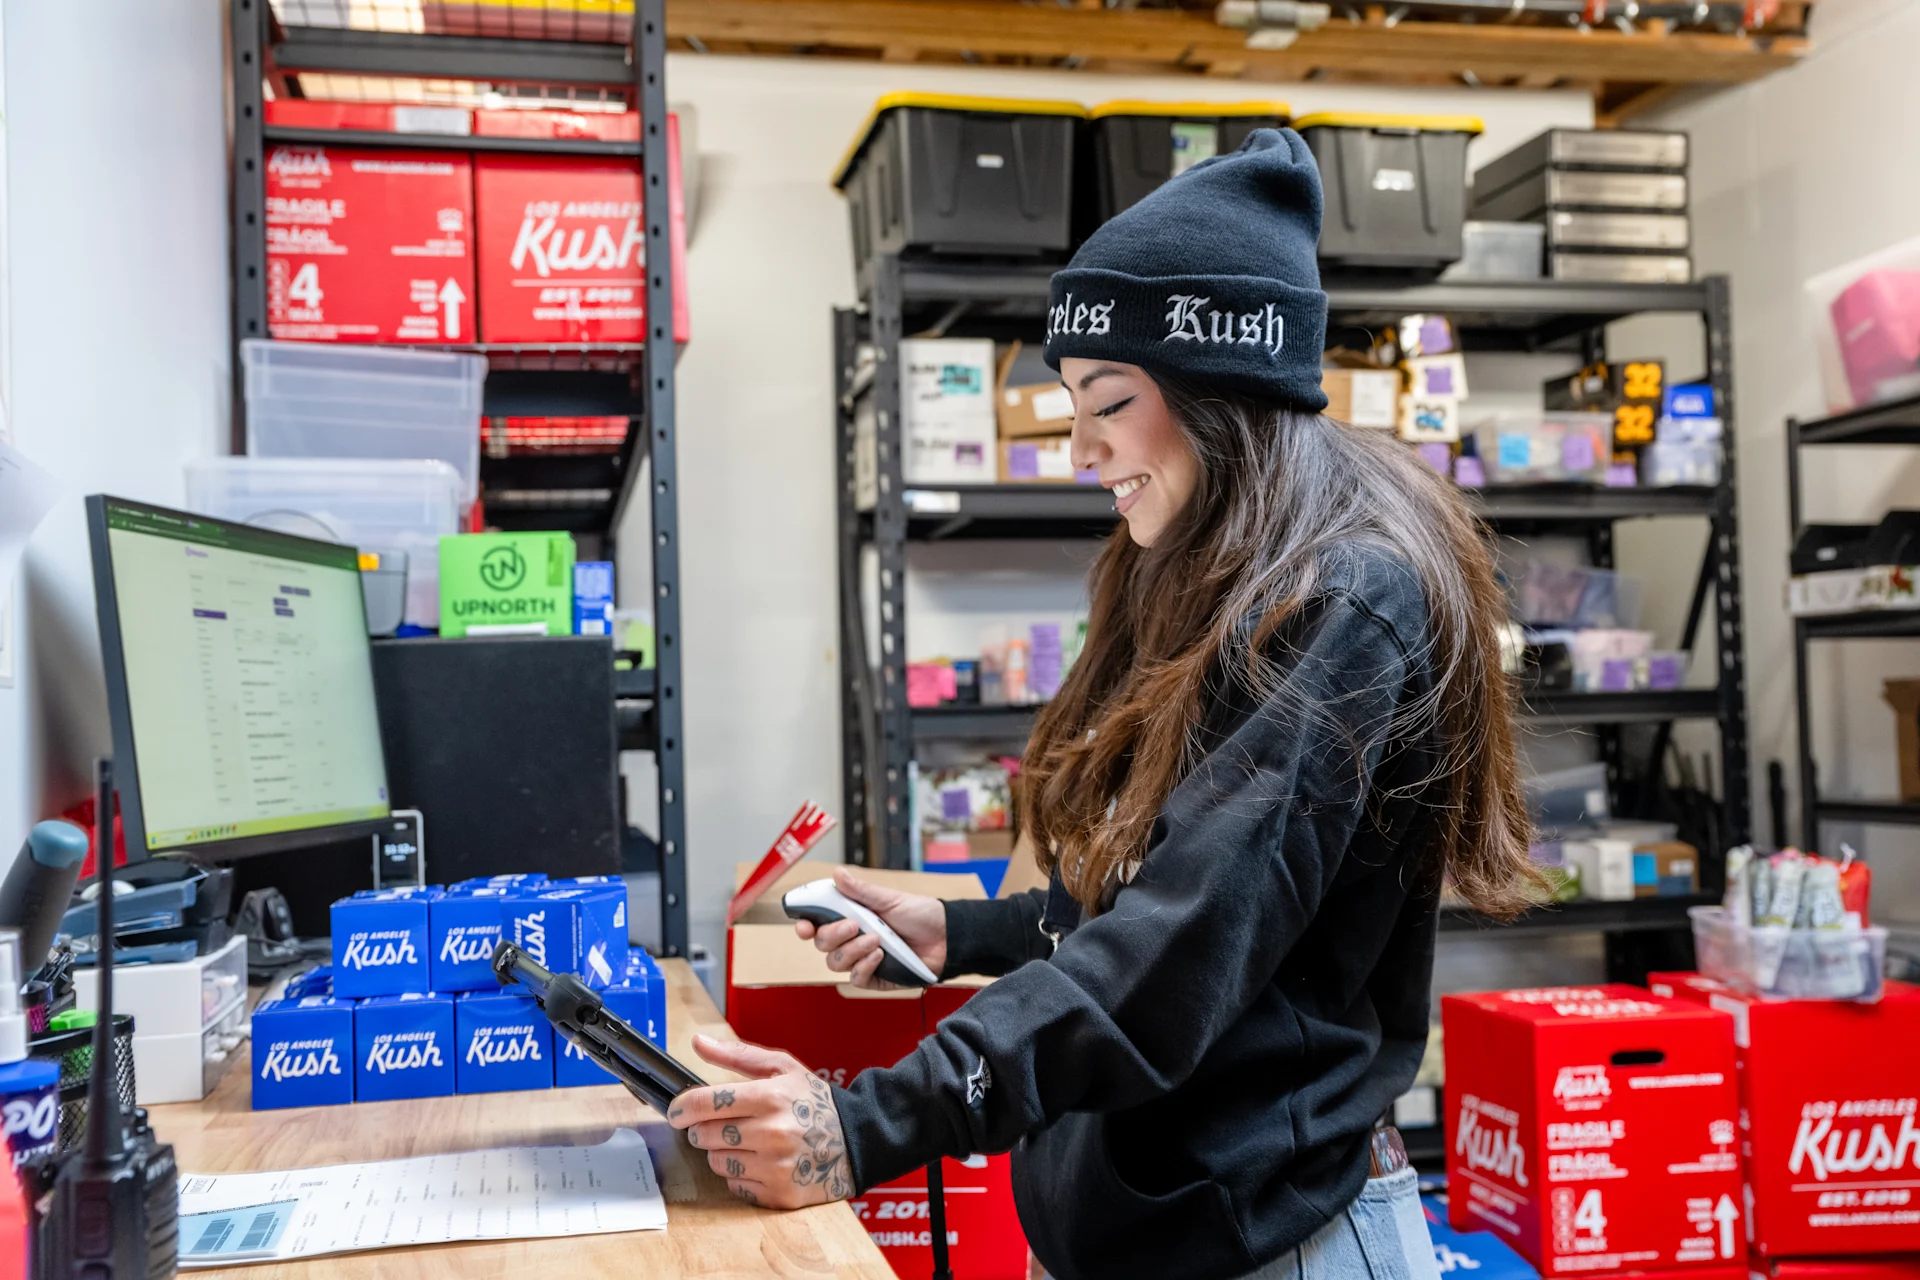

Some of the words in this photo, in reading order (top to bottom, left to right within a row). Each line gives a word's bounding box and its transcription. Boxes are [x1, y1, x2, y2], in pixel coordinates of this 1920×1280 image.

[524, 202, 560, 218] LOS
[510, 217, 646, 277] Kush
[289, 262, 324, 309] 4
[1164, 294, 1284, 356] Kush
[453, 598, 555, 616] UPNORTH
[350, 932, 369, 941] LOS
[369, 929, 411, 940] ANGELES
[447, 927, 466, 936] LOS
[466, 924, 502, 935] ANGELE
[342, 938, 418, 971] Kush
[270, 1042, 290, 1051] LOS
[290, 1038, 334, 1050] ANGELES
[374, 1034, 393, 1044] LOS
[394, 1031, 435, 1042] ANGELES
[474, 1027, 493, 1036] LOS
[493, 1025, 534, 1035] ANGELES
[261, 1047, 342, 1082] Kush
[365, 1040, 443, 1074] Kush
[466, 1033, 542, 1067] Kush
[1801, 1101, 1837, 1119] LOS
[1838, 1098, 1918, 1117] ANGELES
[1547, 1120, 1625, 1139] FRAGILE
[1456, 1107, 1529, 1188] Kush
[1788, 1115, 1920, 1181] Kush
[1575, 1189, 1607, 1237] 4
